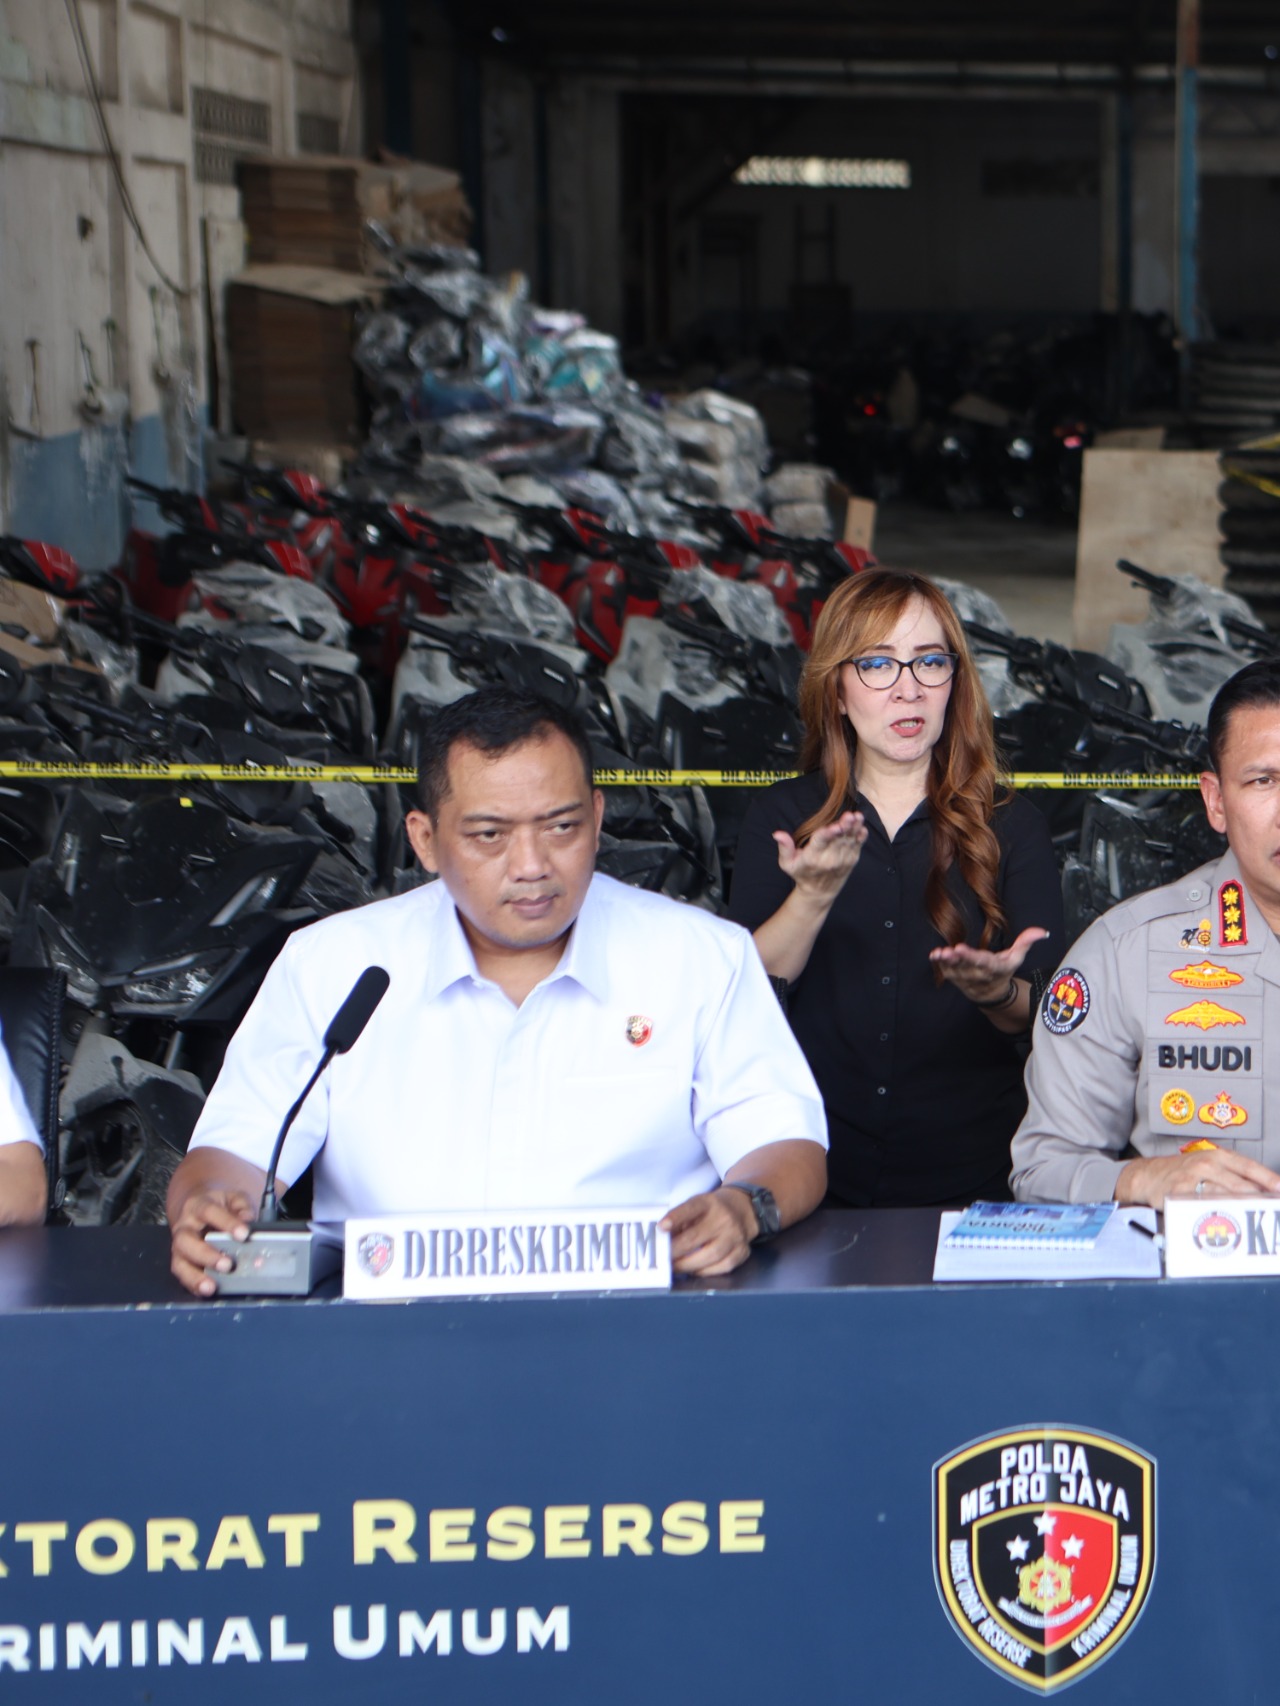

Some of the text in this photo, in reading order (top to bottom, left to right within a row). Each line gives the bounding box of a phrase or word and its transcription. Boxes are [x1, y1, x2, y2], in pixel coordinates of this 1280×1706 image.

[15, 760, 91, 775] DILARANG
[96, 761, 170, 776] MELINTAS
[220, 764, 268, 777] GARIS
[273, 765, 324, 779] POLISI
[593, 769, 617, 782] RIS
[623, 770, 673, 783] POLISI
[1063, 773, 1134, 787] DILARANG
[1138, 773, 1200, 788] MELINTA
[1158, 1045, 1252, 1071] BHUDI
[402, 1221, 659, 1279] DIRRESKRIMUM
[1001, 1443, 1090, 1477] POLDA
[961, 1472, 1130, 1526] METRO JAYA
[0, 1497, 765, 1578] TORAT RESERSE
[1118, 1534, 1139, 1586] UMUM
[950, 1539, 988, 1625] DIREKTORAT
[332, 1602, 571, 1661] UMUM
[1070, 1588, 1132, 1659] KRIMINAL
